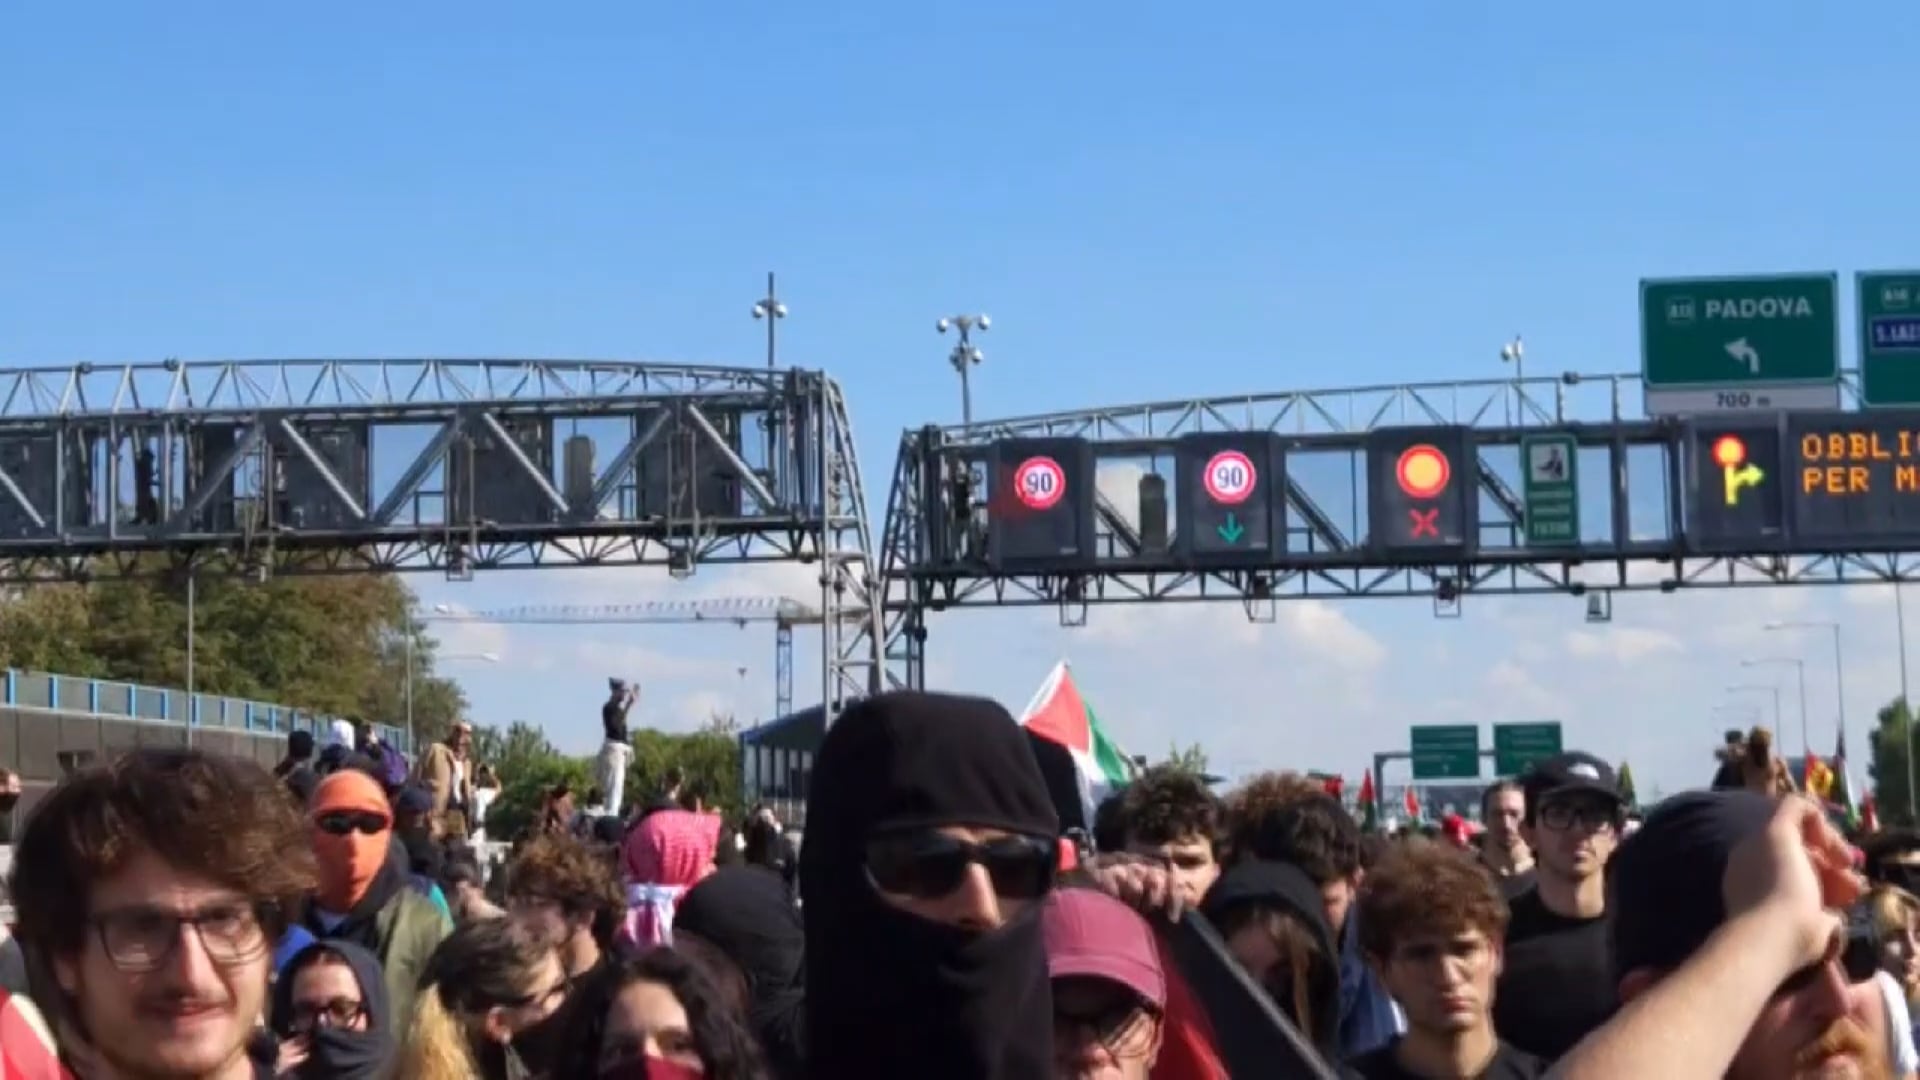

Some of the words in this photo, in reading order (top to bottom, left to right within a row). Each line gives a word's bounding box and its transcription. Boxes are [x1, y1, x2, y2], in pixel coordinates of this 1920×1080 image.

[1705, 296, 1813, 319] PADOVA
[1717, 392, 1750, 408] 700
[1802, 430, 1920, 460] OBBLI
[1026, 472, 1053, 494] 90
[1217, 466, 1243, 489] 90
[1803, 466, 1870, 494] PER
[1895, 463, 1920, 492] M
